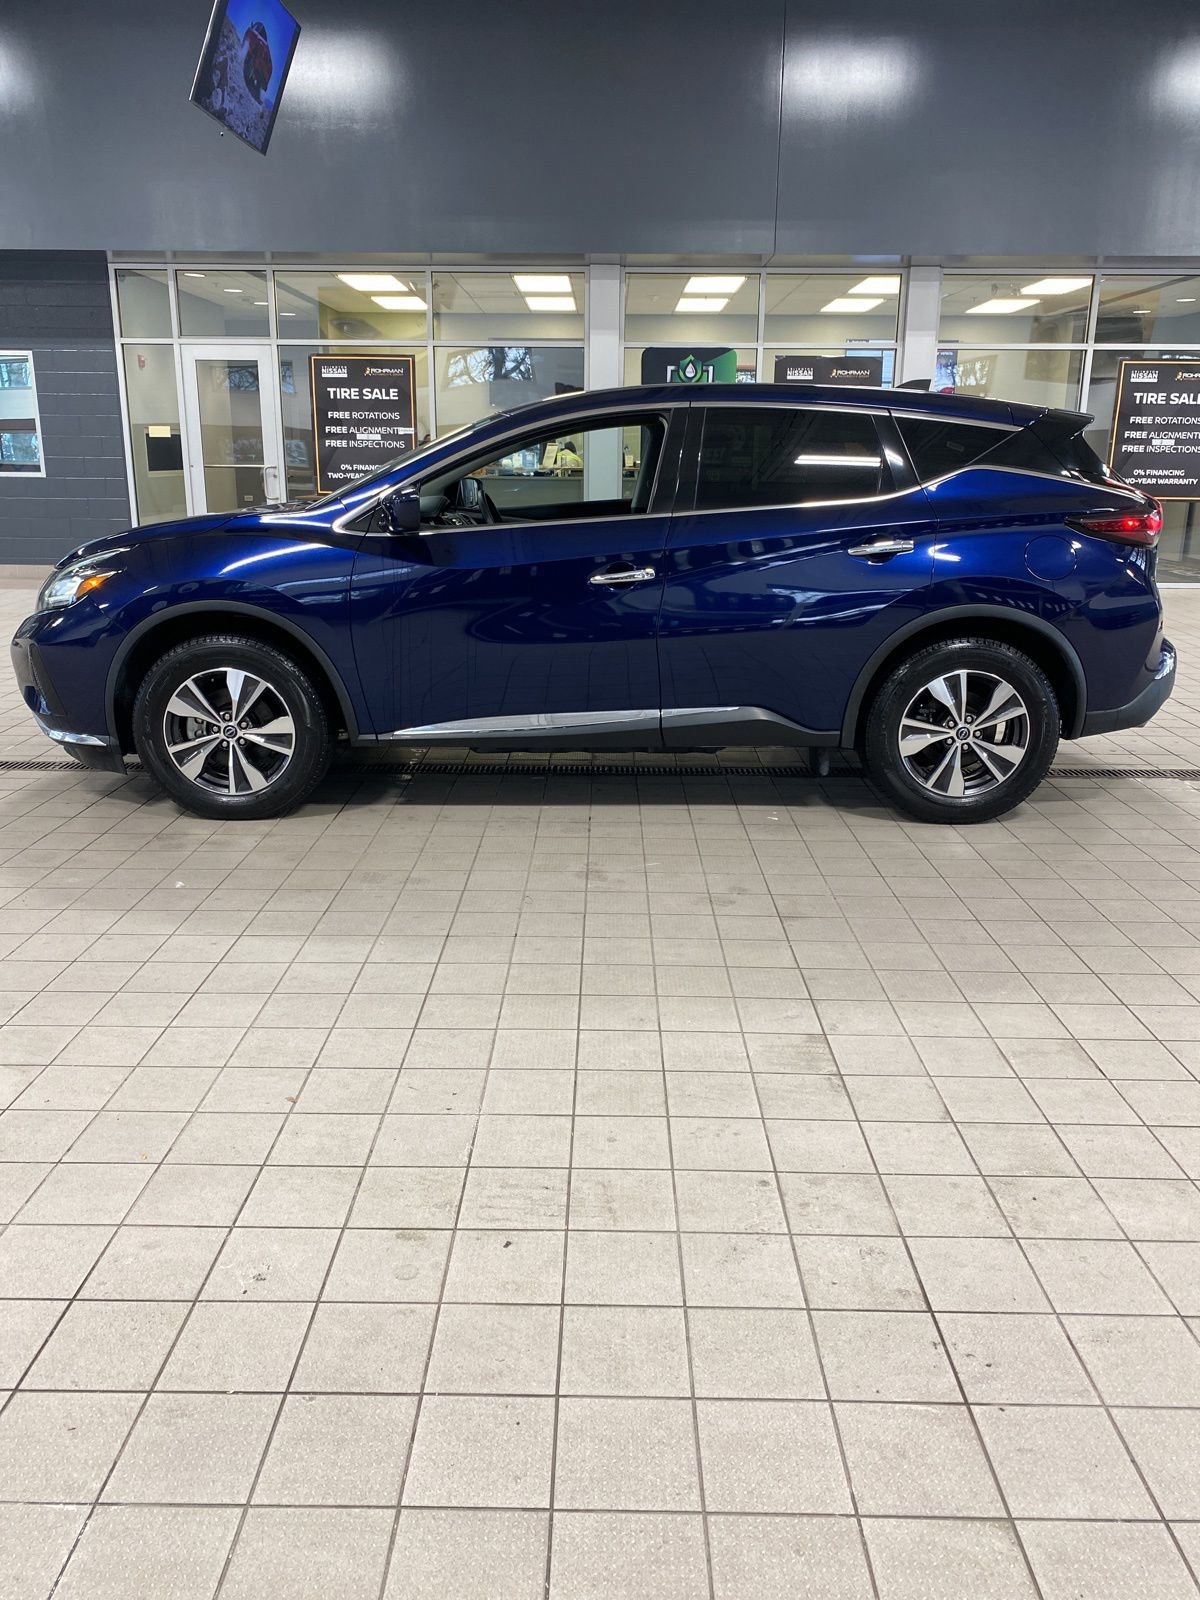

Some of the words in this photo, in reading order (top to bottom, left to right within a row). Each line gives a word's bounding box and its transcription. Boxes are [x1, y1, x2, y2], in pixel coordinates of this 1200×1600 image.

[327, 388, 359, 399] TIRE
[362, 388, 399, 400] SALE
[1134, 393, 1167, 404] TIRE
[328, 411, 350, 419] FREE
[352, 412, 400, 420] ROTATIONS
[1130, 416, 1153, 424] FREE
[325, 426, 348, 434] FREE
[349, 426, 402, 434] ALIGNMENT
[1124, 431, 1148, 439] FREE
[1149, 431, 1200, 440] ALIGNMENT
[325, 440, 348, 448] FREE
[349, 440, 405, 449] INSPECTIONS
